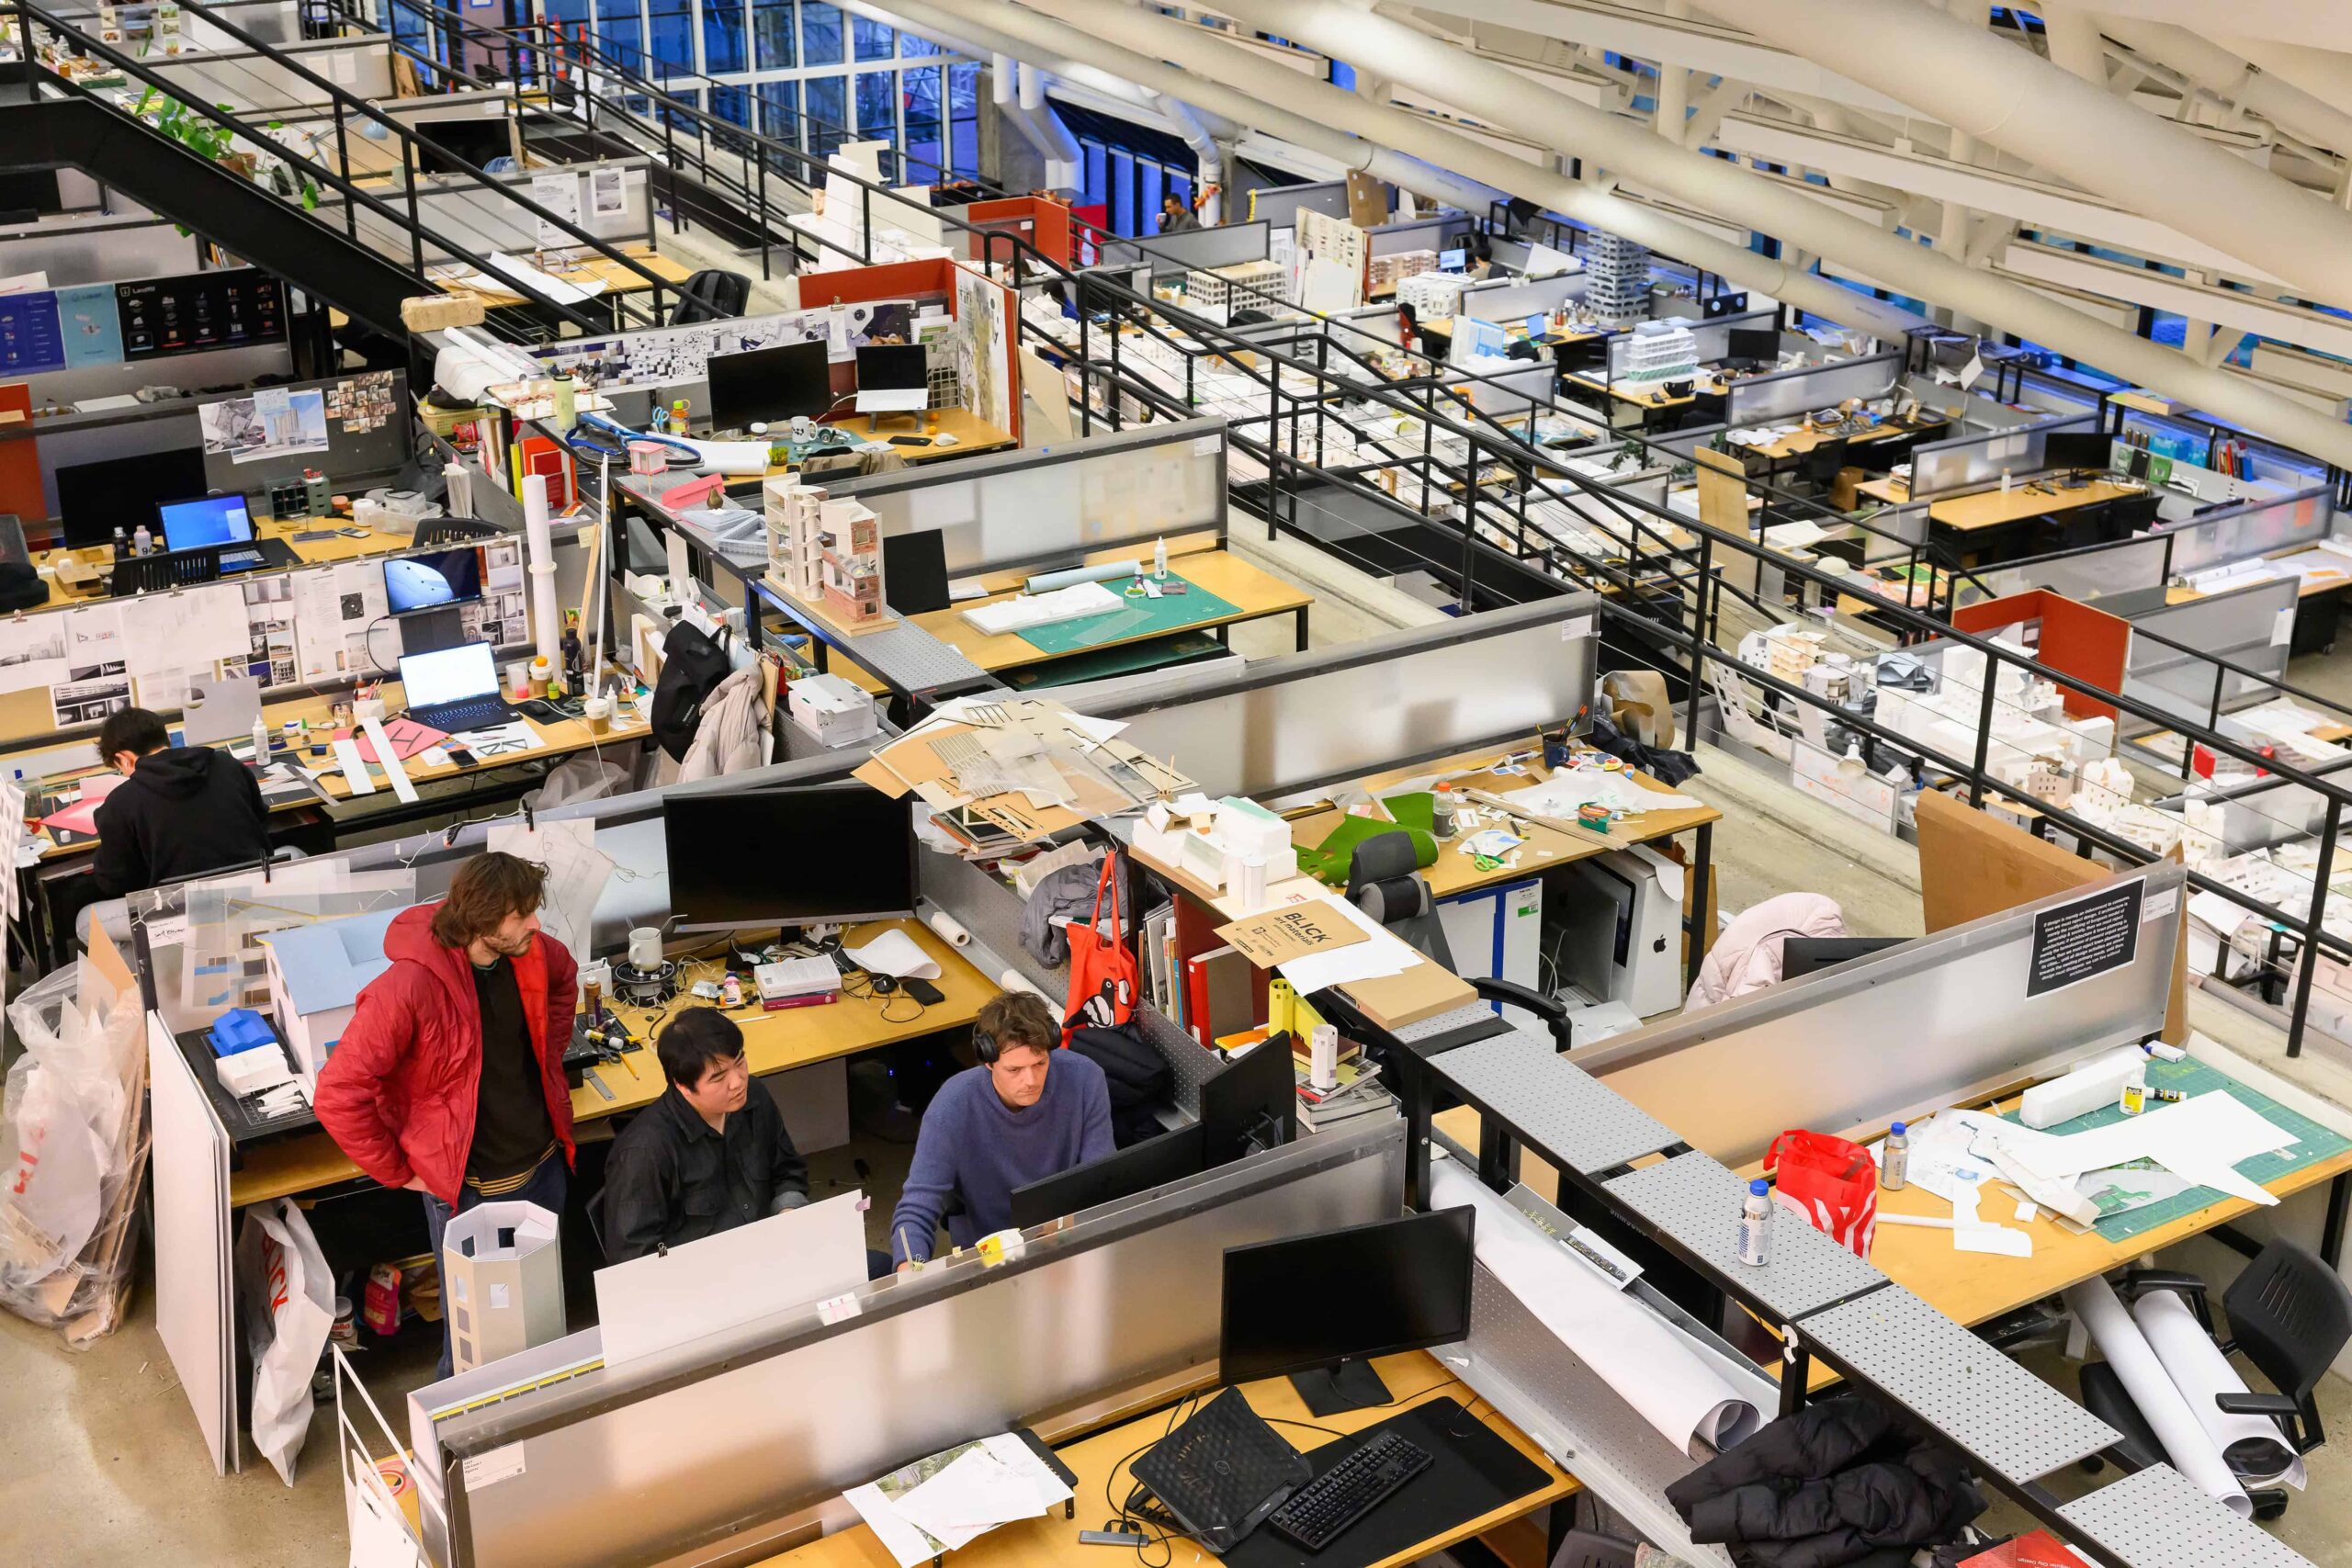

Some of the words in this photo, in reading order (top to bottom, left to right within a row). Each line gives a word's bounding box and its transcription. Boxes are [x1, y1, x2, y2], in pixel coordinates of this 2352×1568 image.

[1273, 916, 1286, 924] art
[1285, 923, 1315, 947] materials
[1284, 912, 1332, 942] BLICK
[2017, 1557, 2037, 1565] Design
